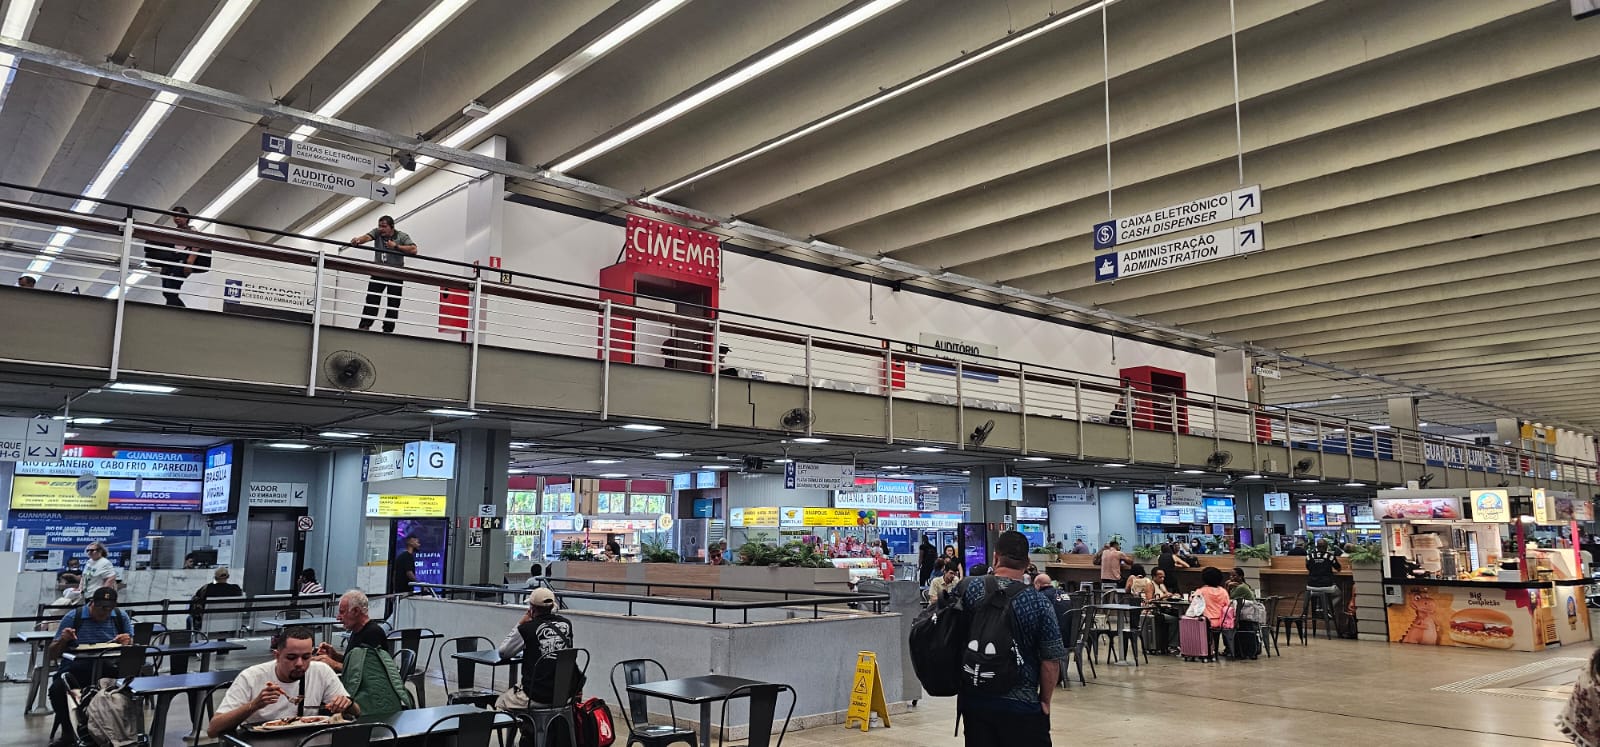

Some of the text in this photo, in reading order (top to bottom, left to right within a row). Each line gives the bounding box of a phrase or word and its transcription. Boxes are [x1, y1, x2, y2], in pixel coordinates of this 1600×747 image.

[296, 150, 339, 164] CASH MACHINE
[297, 143, 372, 165] CAIXAS ELETRÔNICOS
[292, 178, 335, 191] AUDITORIUM
[293, 168, 355, 188] AUDITÓRIO
[1120, 196, 1228, 230] CAIXA ELETRÔNICO
[1121, 210, 1217, 240] CASH DISPENSER
[1123, 234, 1215, 262] ADMINISTRAÇÃO
[1123, 245, 1219, 274] ADMINISTRATION
[126, 451, 184, 461] GUANABARA
[407, 451, 415, 468] G
[429, 452, 444, 469] G
[100, 461, 124, 470] CABO
[126, 461, 146, 471] FRIO
[152, 462, 198, 472] APARECIDA
[995, 483, 1001, 494] F
[1012, 483, 1017, 494] F
[888, 494, 913, 505] JANEIRO
[1269, 497, 1276, 506] E
[1469, 592, 1482, 601] Big
